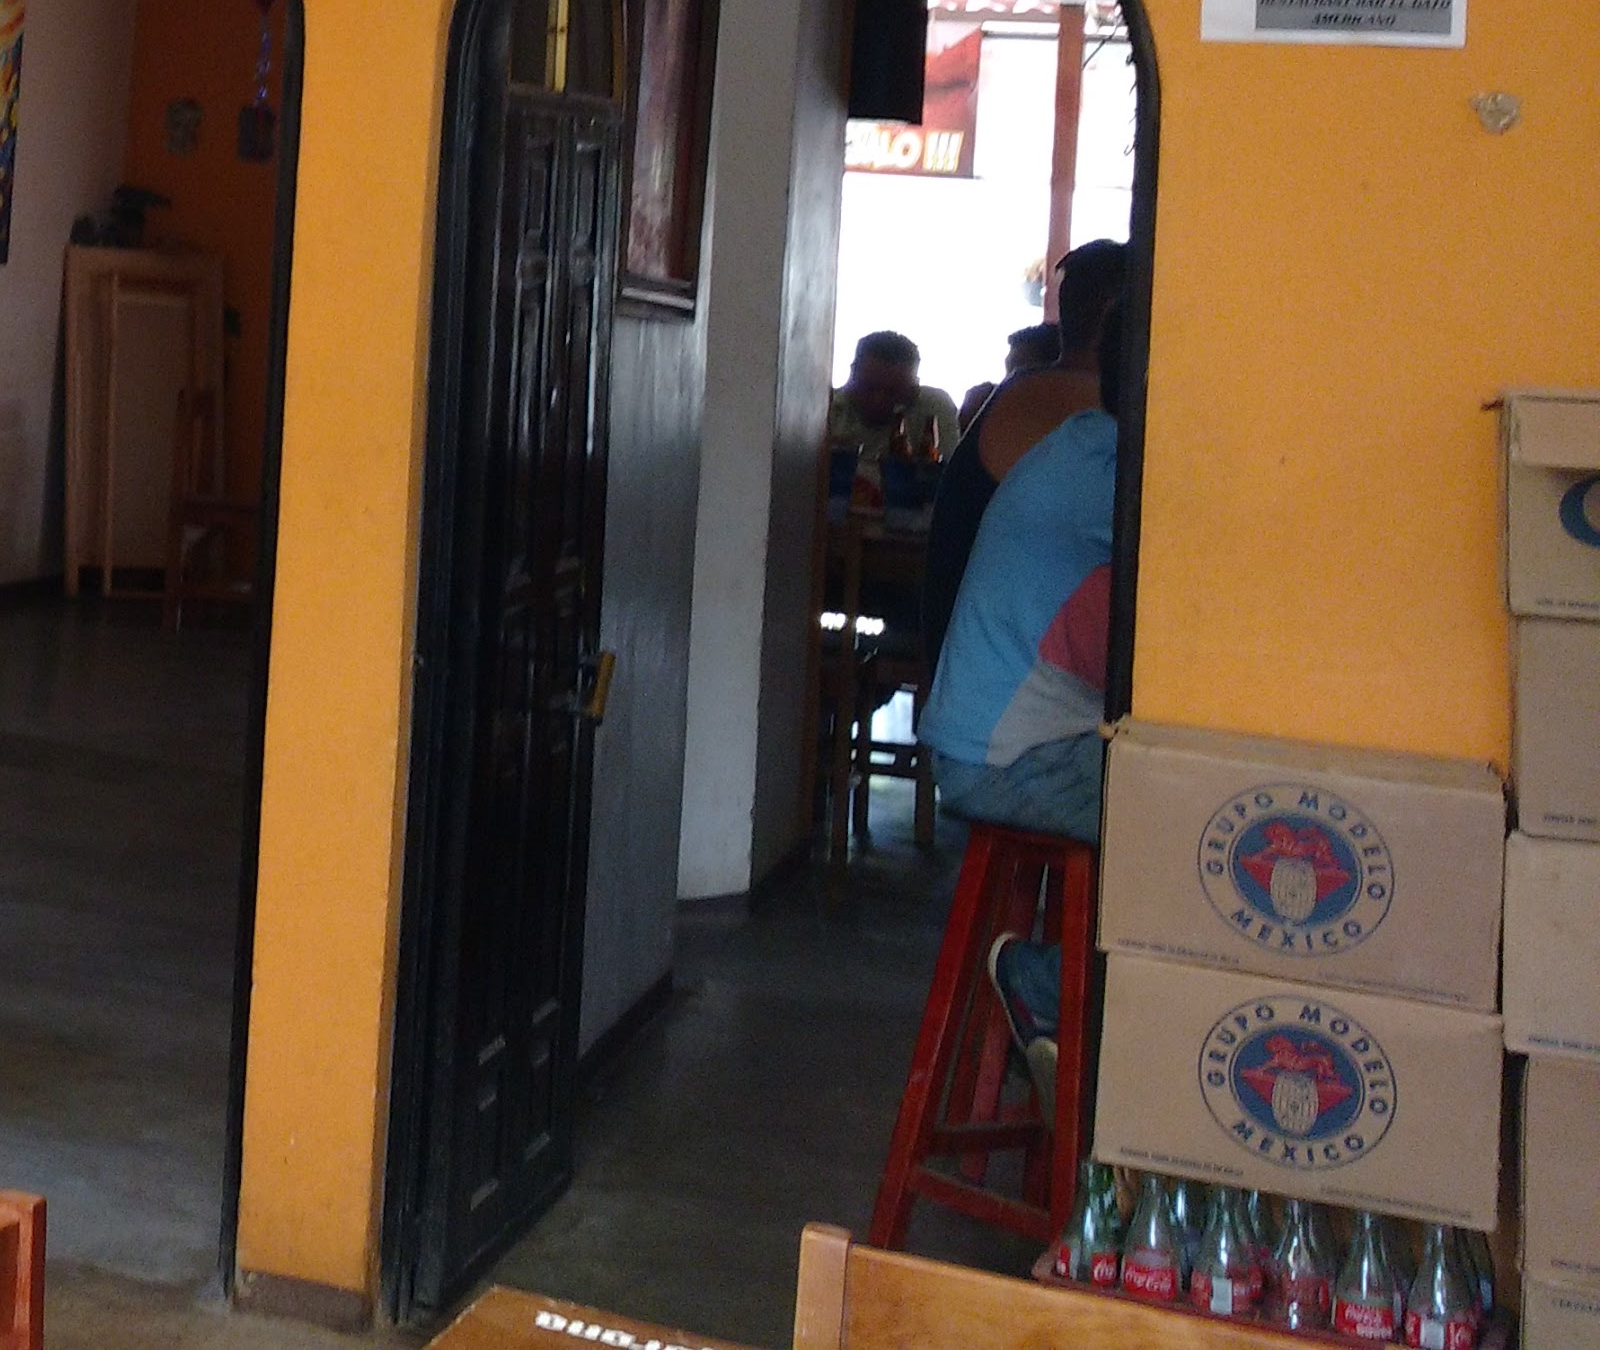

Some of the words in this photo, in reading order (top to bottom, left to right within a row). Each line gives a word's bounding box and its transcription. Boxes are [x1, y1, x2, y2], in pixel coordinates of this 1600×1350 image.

[1206, 792, 1274, 875] GRUPO
[1299, 791, 1386, 900] MODELO
[1231, 908, 1363, 950] MEXICO
[1207, 1004, 1275, 1087] GRUPO
[1299, 1004, 1389, 1115] MODELO
[1233, 1120, 1364, 1164] MEXICO
